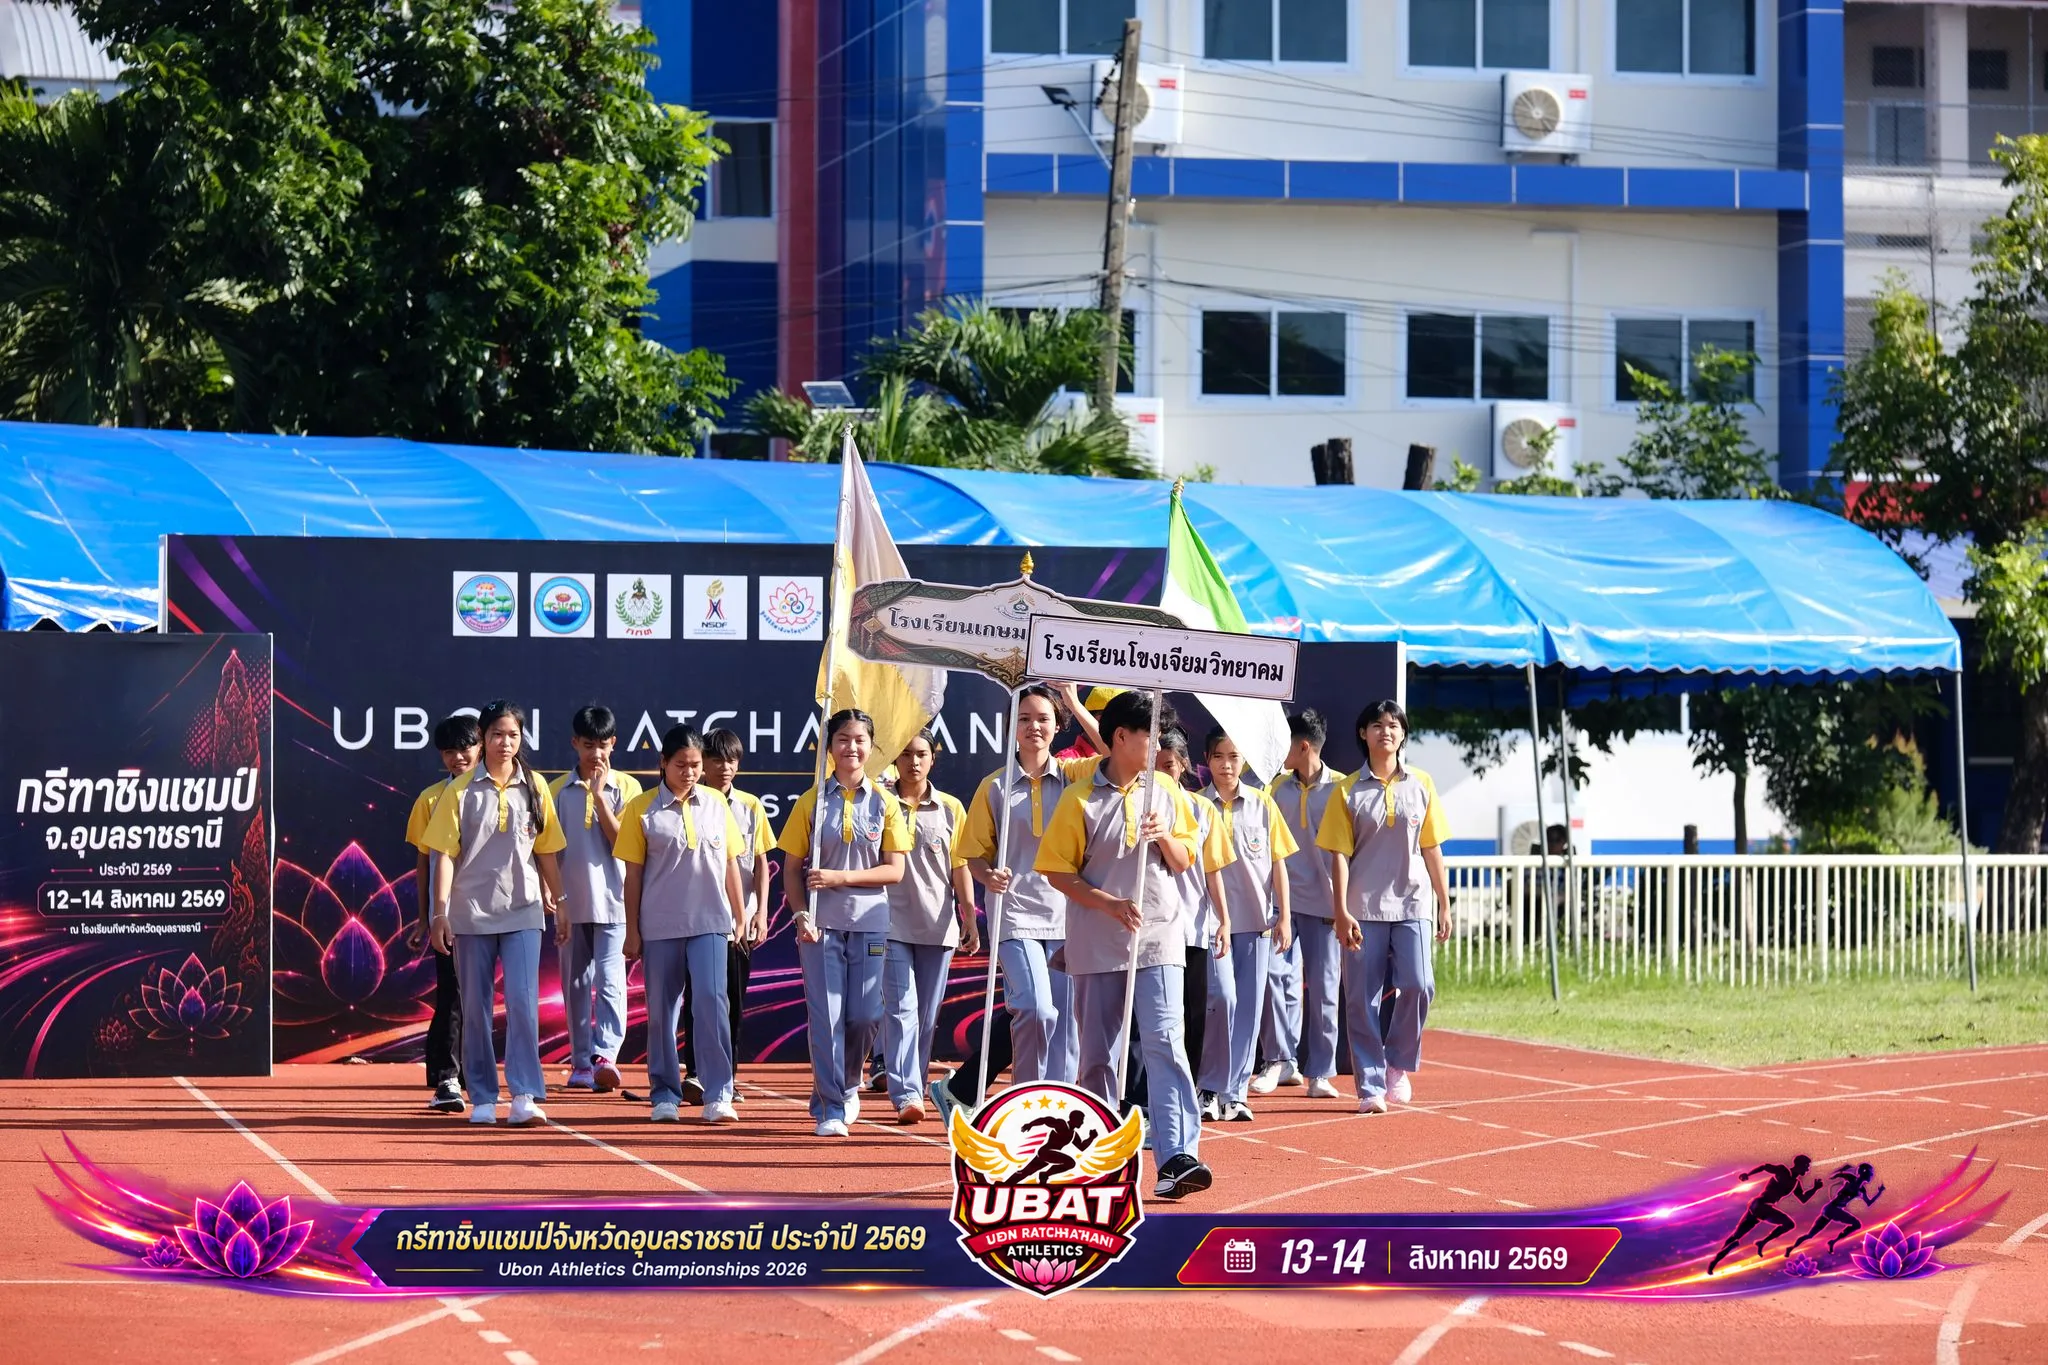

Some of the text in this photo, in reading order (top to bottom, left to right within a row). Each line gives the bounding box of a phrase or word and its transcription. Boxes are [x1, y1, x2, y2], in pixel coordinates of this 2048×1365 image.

[889, 606, 1027, 641] โรงเรียนเกษม
[1043, 633, 1284, 682] โรงเรียนโขงเจียมวิทยาคม
[333, 706, 540, 751] UBN
[16, 766, 259, 814] กรีฑาชิงแชมป์
[45, 816, 224, 859] จ.อุบลราชธานี
[99, 861, 173, 877] ประจำปี 2569
[110, 888, 176, 909] สิงหาคม
[181, 889, 226, 908] 2569
